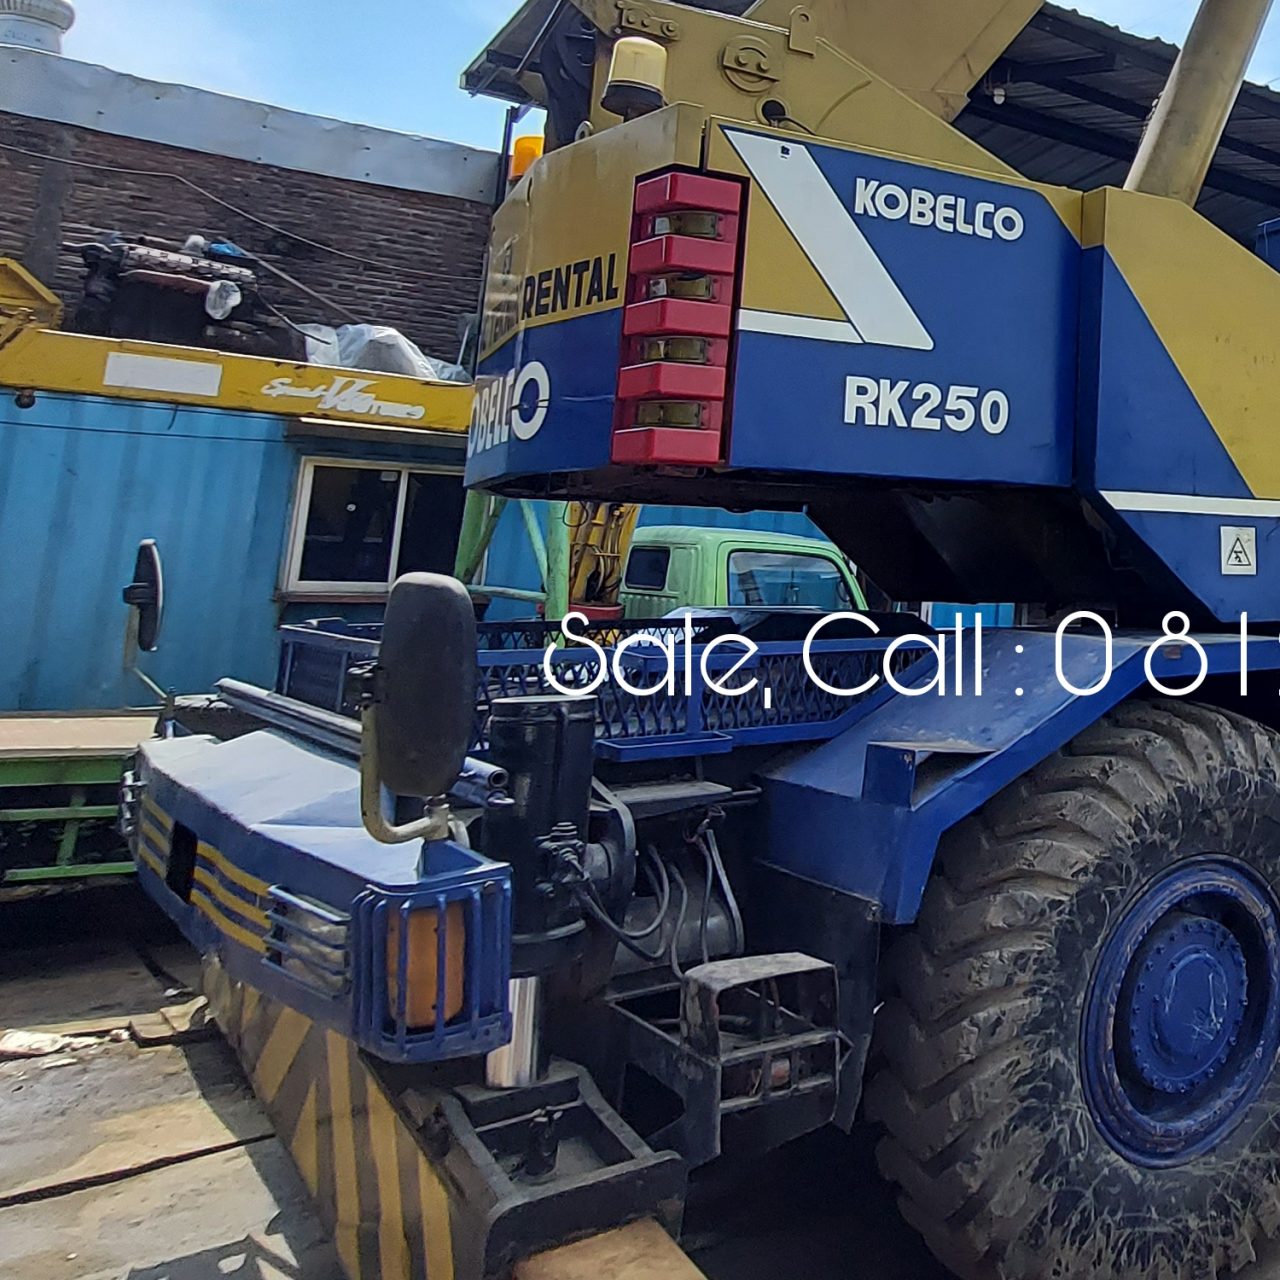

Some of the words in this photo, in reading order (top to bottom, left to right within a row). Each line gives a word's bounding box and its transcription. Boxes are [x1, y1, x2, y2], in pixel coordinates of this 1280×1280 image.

[854, 177, 1025, 241] KOBELCO
[521, 252, 619, 321] RENTAL
[468, 360, 550, 459] OBELCO
[843, 375, 1010, 435] RK250
